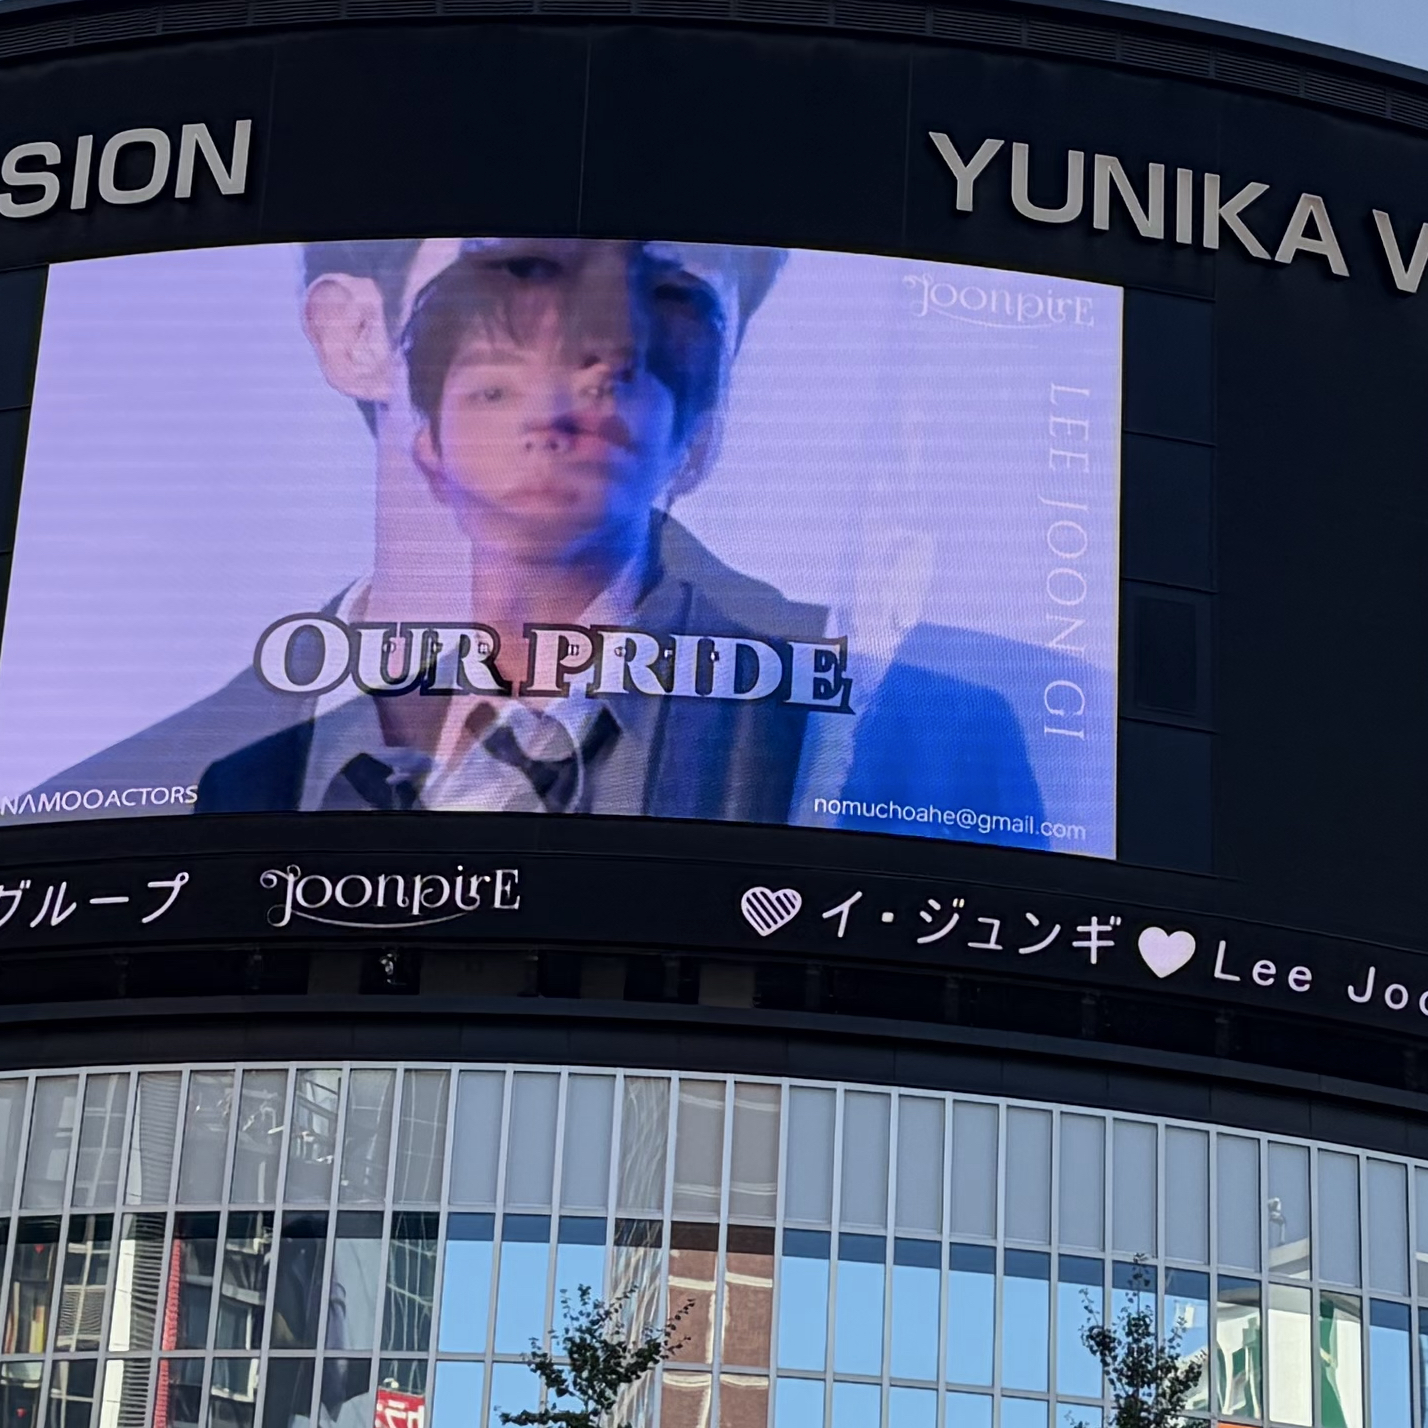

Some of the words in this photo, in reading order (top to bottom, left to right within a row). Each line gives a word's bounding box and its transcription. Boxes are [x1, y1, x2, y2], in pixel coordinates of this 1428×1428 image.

[928, 131, 1351, 280] YUNIKA
[1048, 383, 1091, 473] LEE
[1038, 494, 1090, 657] JOON
[254, 611, 512, 700] OUR
[522, 622, 855, 715] PRIDE
[1043, 679, 1087, 741] GI
[813, 796, 1087, 842] nomuchoahe@gmail.com
[822, 890, 1122, 964] イ・ジュンギ
[1213, 940, 1313, 993] Lee
